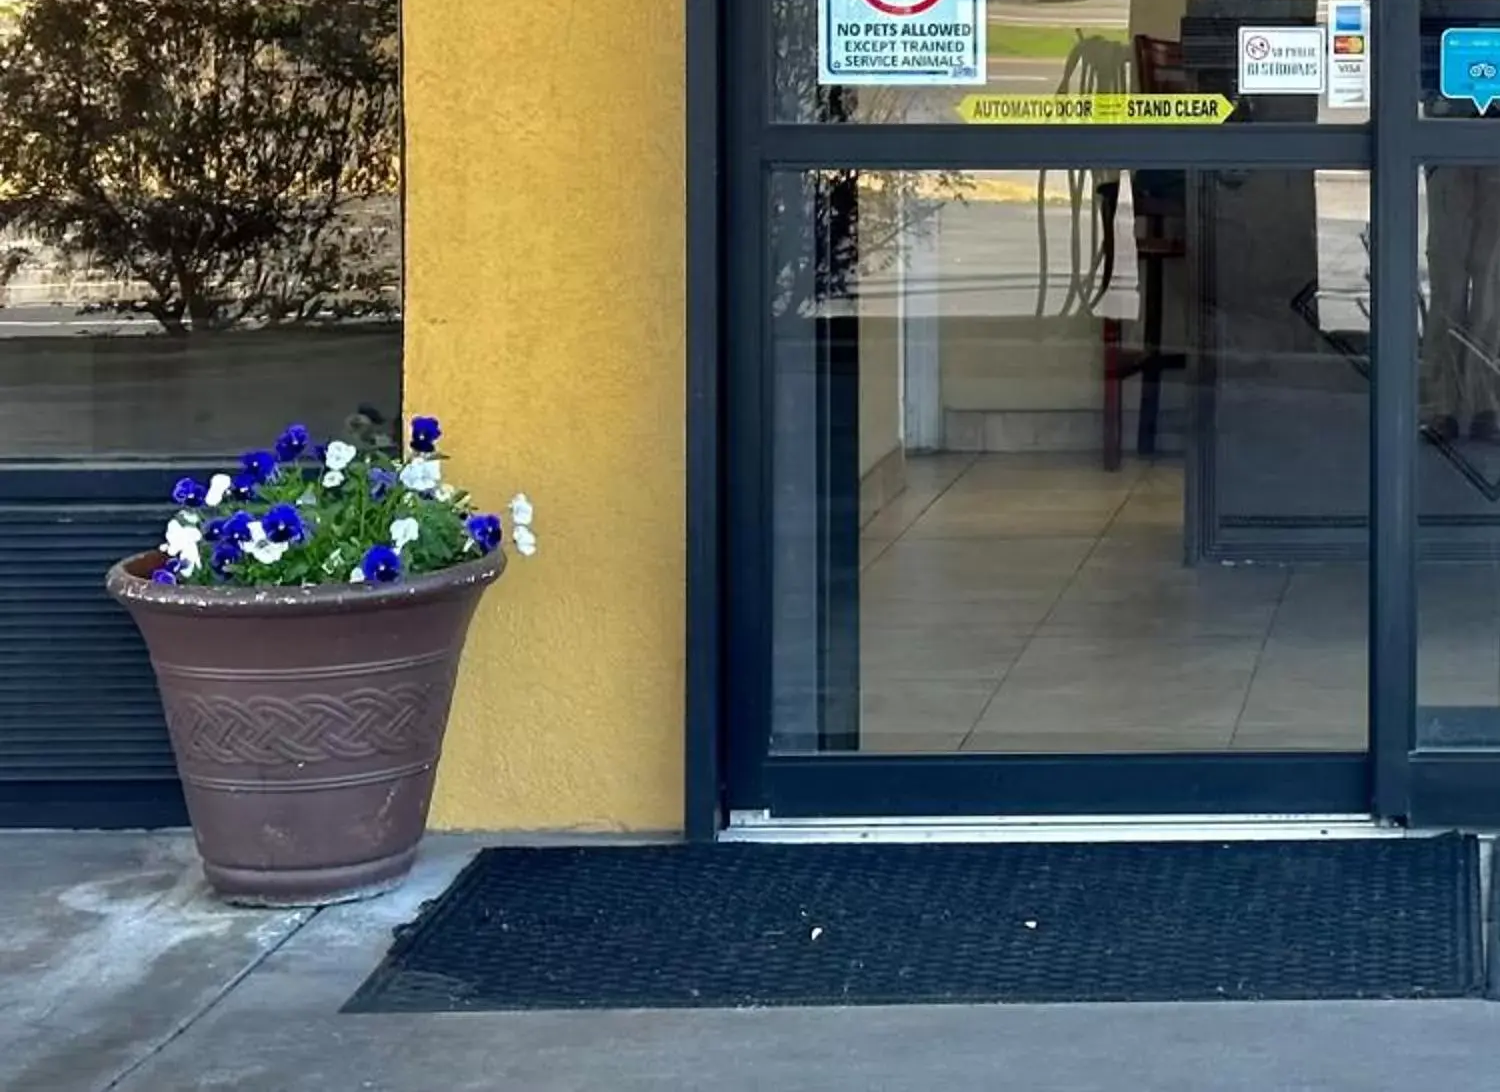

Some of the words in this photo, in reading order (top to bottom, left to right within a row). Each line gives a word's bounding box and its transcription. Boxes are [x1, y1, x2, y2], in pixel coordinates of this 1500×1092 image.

[837, 23, 861, 36] NO
[864, 23, 898, 37] PETS
[901, 23, 972, 37] ALLOWED
[845, 41, 897, 53] EXCEPT
[902, 41, 965, 53] TRAINED
[844, 55, 898, 67] SERVICE
[901, 55, 965, 68] ANIMALS
[973, 99, 1053, 118] AUTOMATIC
[1056, 99, 1093, 117] DOOR
[1127, 99, 1172, 117] STAND
[1175, 99, 1219, 117] CLEAR
